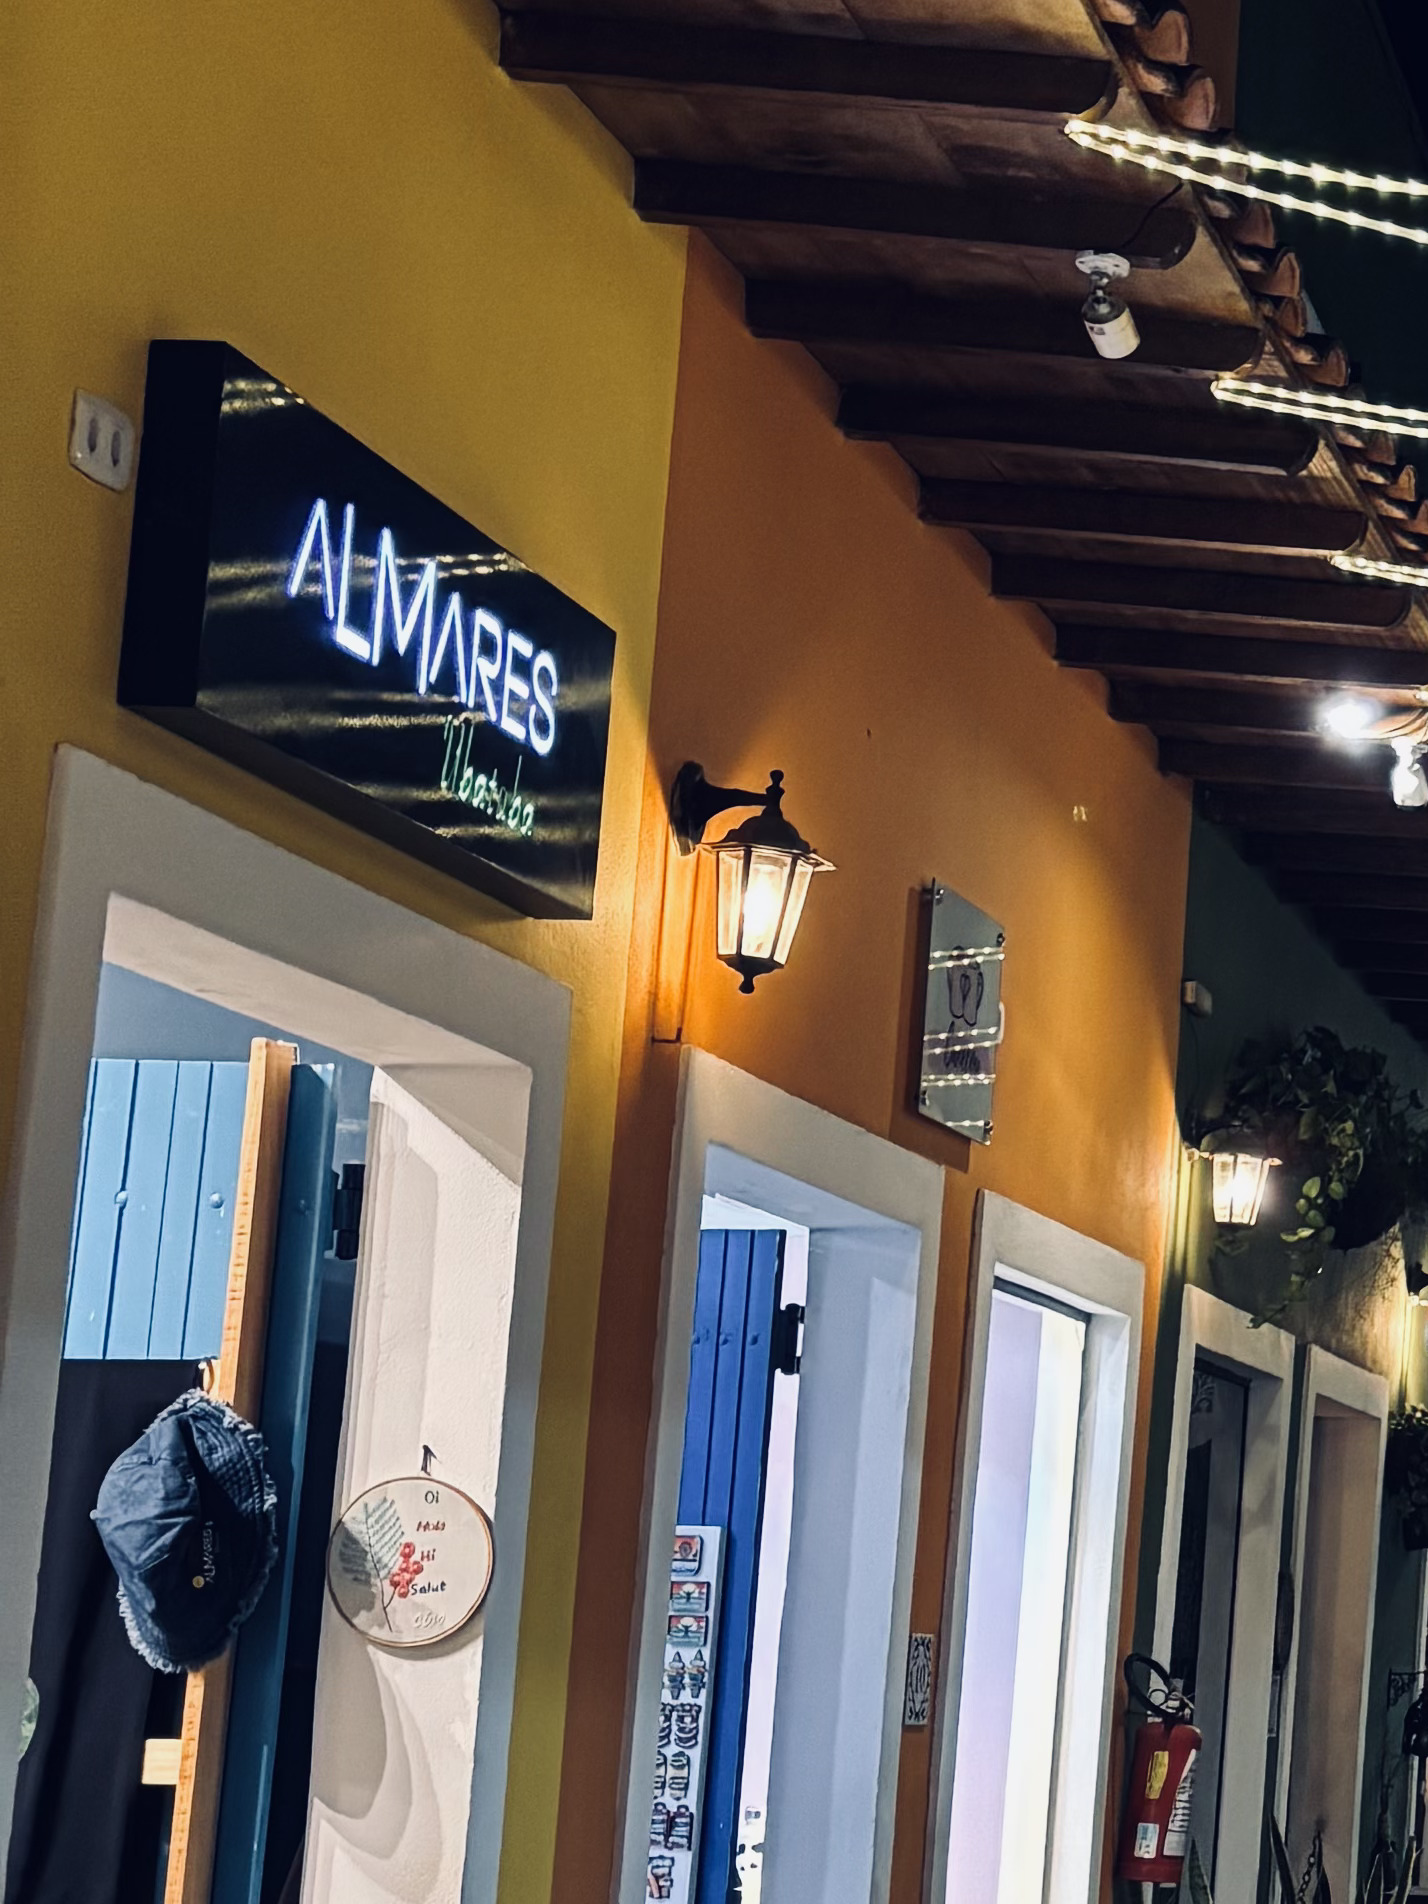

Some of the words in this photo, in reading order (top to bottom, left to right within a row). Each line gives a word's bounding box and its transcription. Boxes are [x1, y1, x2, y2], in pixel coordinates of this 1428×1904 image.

[288, 498, 559, 758] ALMARES
[424, 1489, 440, 1504] Oi
[420, 1548, 436, 1562] Hi
